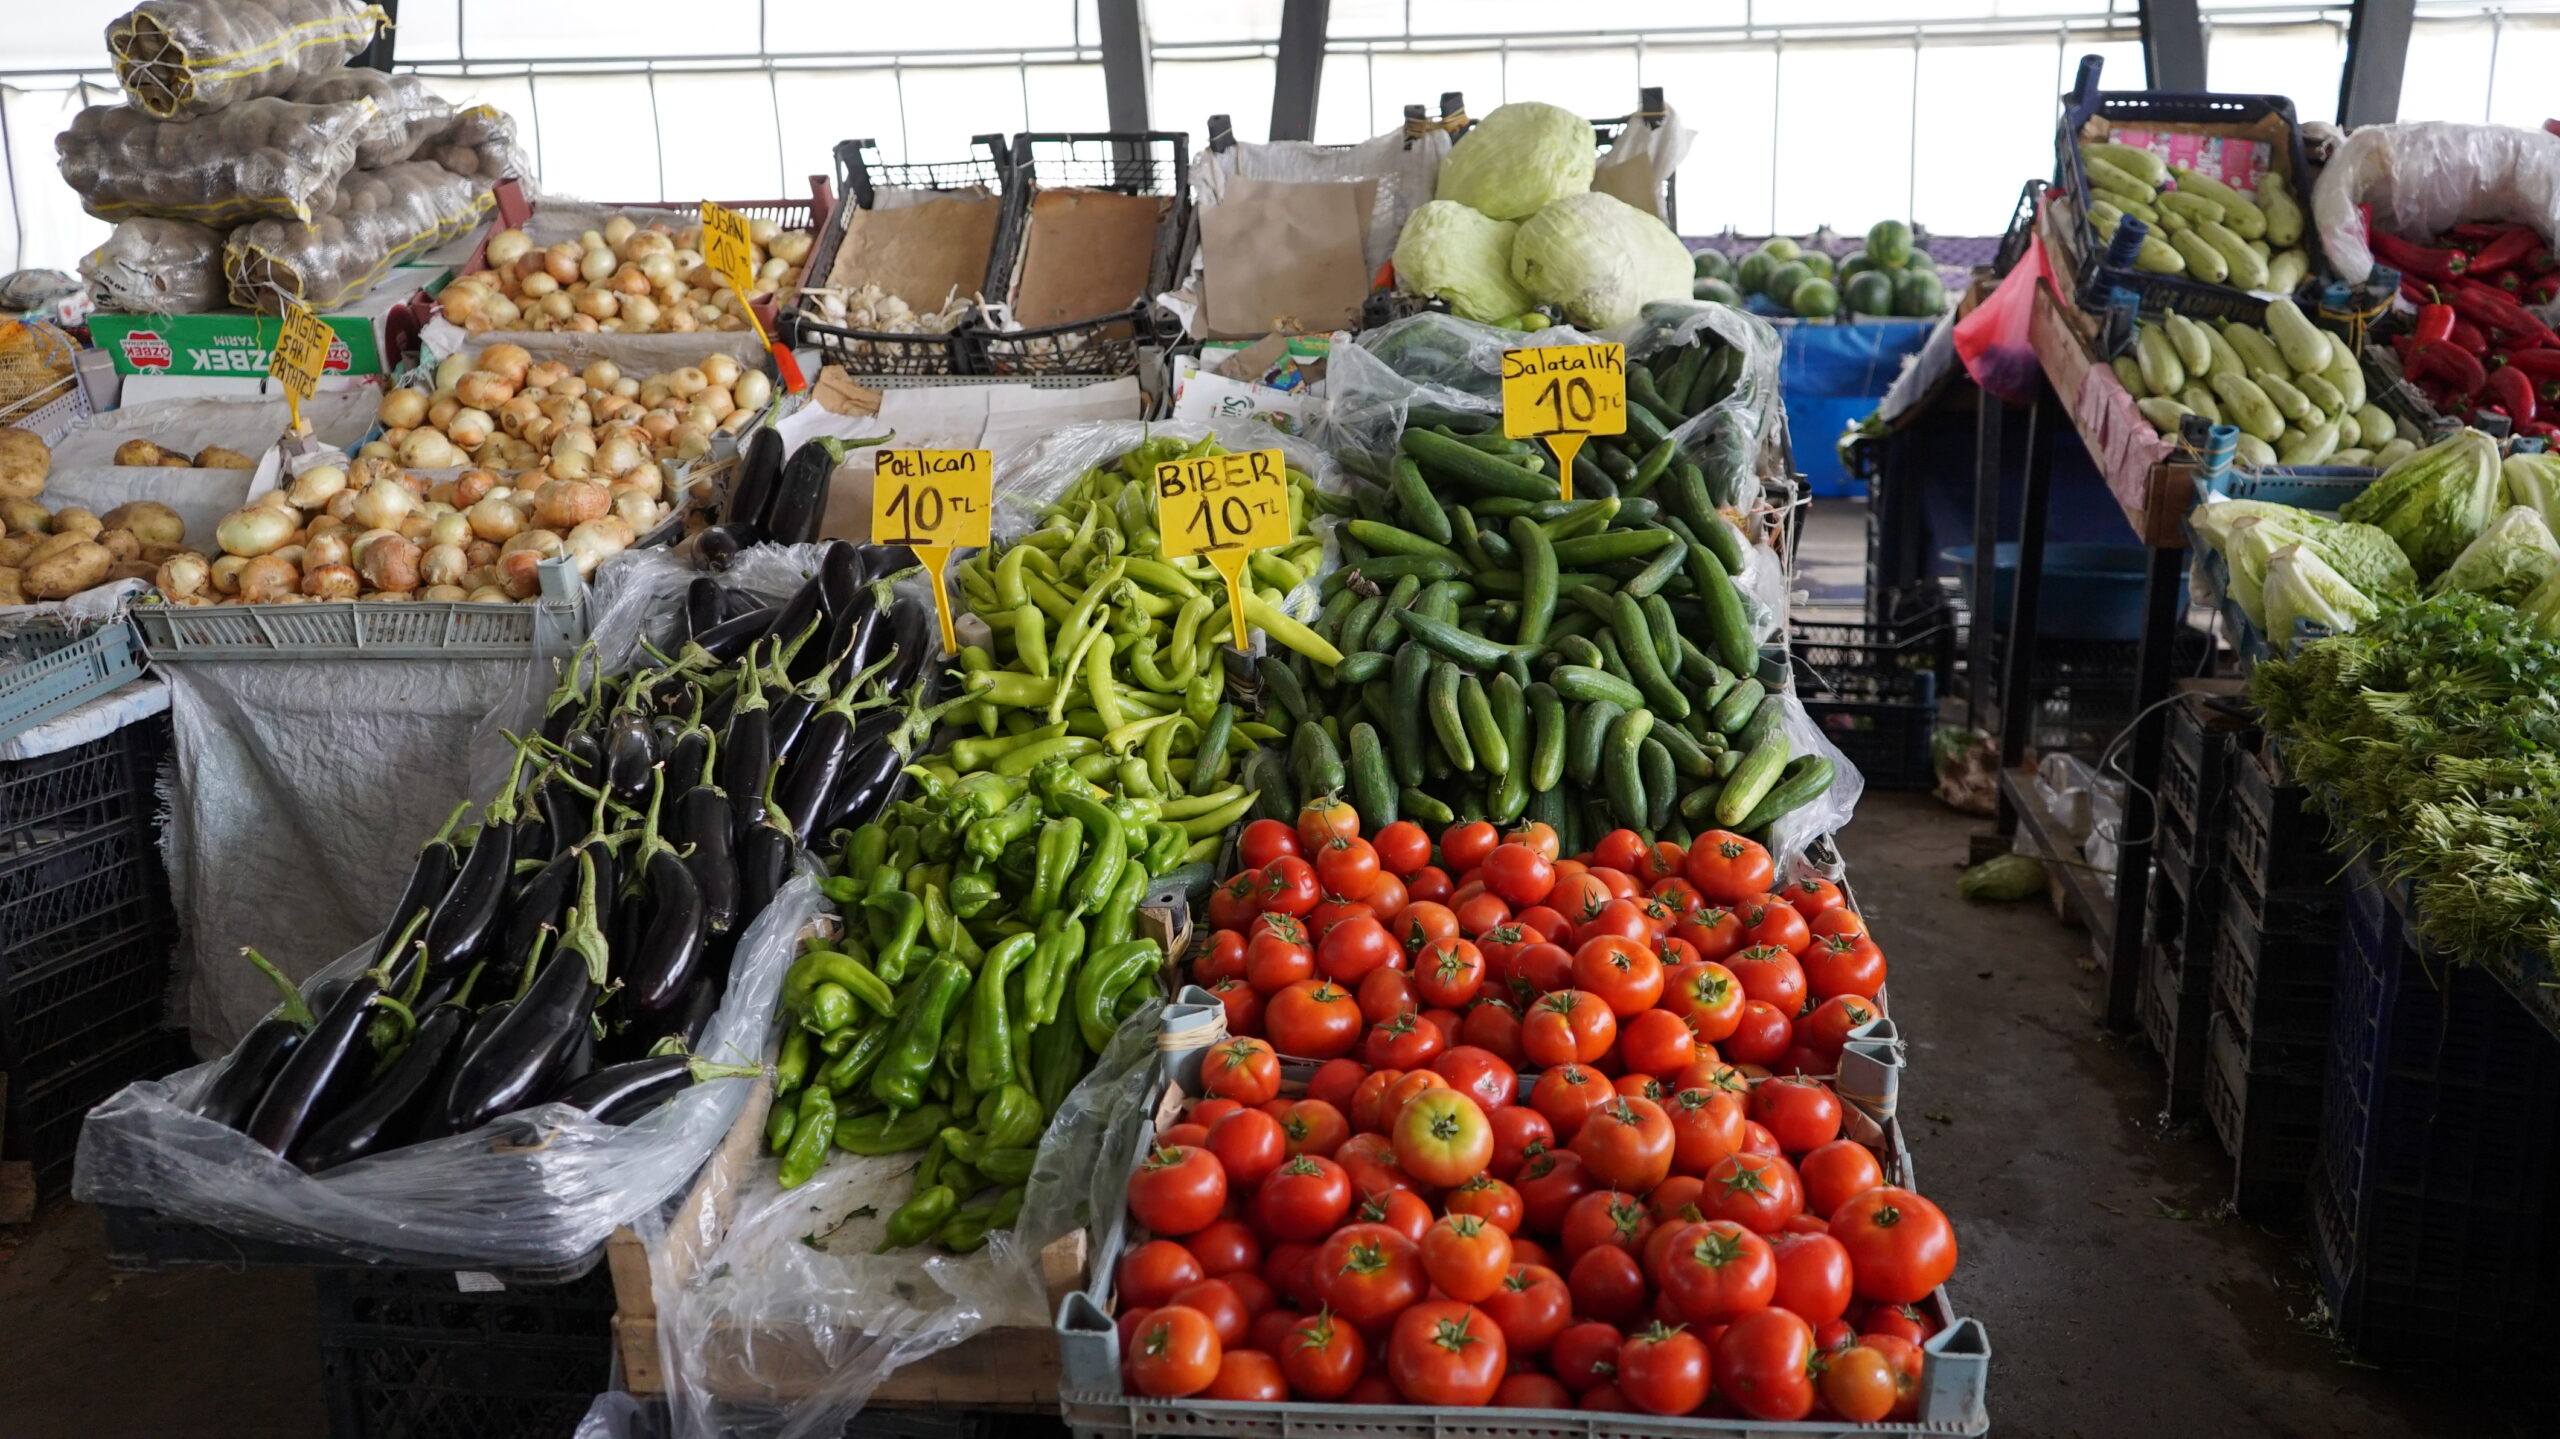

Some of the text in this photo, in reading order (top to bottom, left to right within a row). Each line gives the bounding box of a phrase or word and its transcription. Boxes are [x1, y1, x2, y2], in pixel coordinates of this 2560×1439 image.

[712, 235, 736, 280] 10
[213, 335, 256, 347] TARIM
[278, 335, 310, 364] SARI
[269, 350, 317, 401] PATATES
[1533, 376, 1595, 436] 10
[883, 484, 943, 544] 10
[1186, 495, 1280, 554] 10 TL
